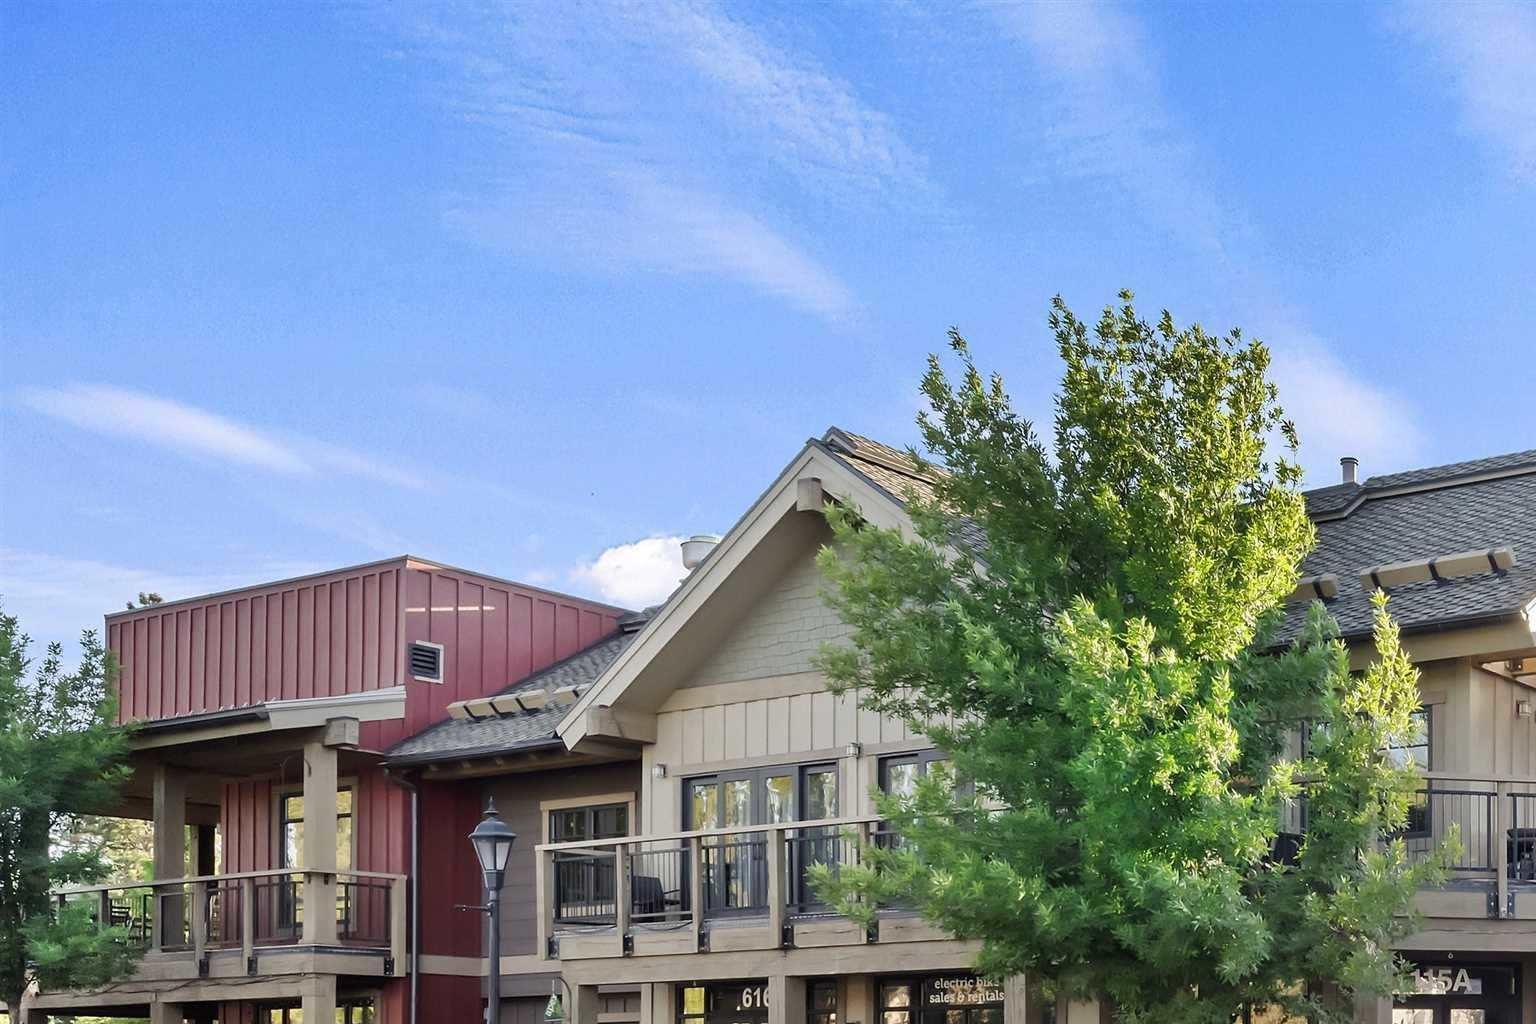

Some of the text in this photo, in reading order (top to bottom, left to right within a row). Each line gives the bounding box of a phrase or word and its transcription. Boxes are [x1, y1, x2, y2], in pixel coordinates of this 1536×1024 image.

[934, 977, 975, 989] electric
[929, 991, 956, 1004] sales
[967, 989, 1005, 1003] rentals
